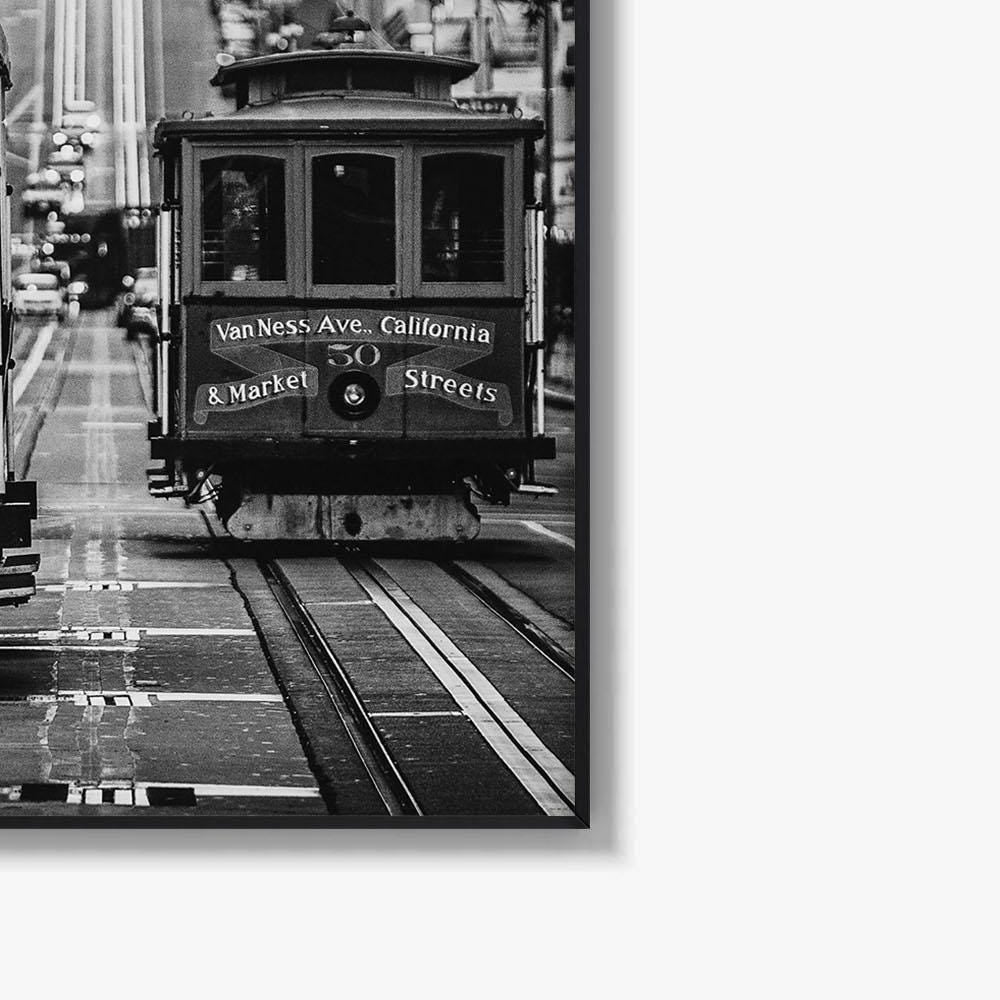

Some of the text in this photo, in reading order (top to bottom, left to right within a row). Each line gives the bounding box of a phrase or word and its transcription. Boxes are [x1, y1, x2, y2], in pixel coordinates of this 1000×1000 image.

[216, 323, 254, 342] Van
[257, 317, 310, 337] Ness
[380, 315, 490, 344] California
[327, 343, 381, 367] 50
[208, 371, 309, 405] & Market
[404, 368, 498, 402] Streets
